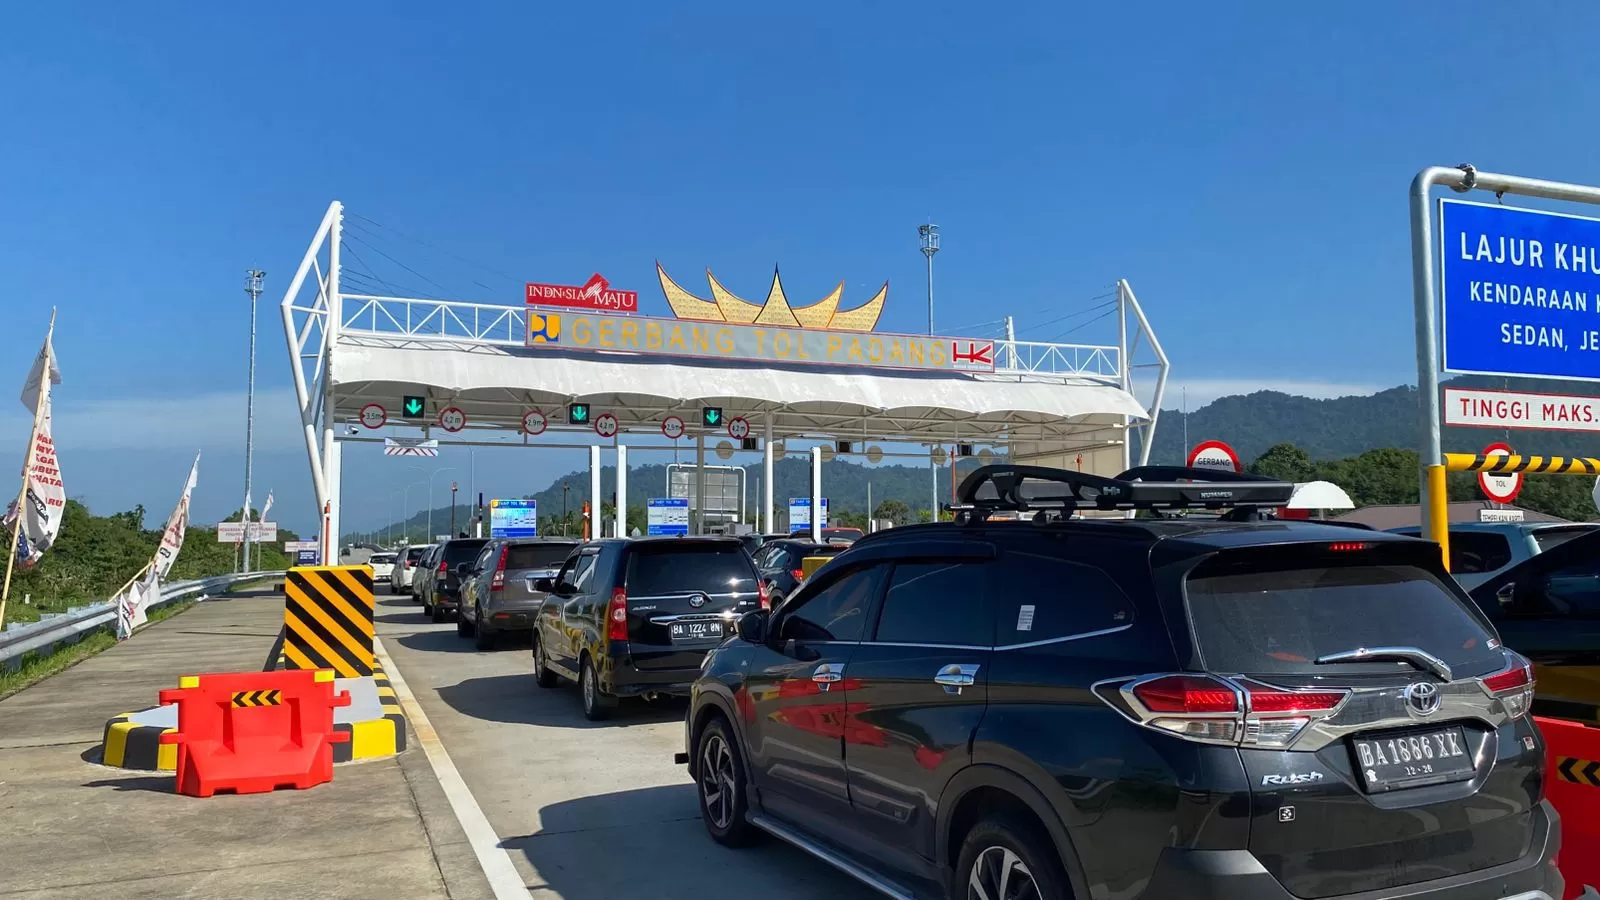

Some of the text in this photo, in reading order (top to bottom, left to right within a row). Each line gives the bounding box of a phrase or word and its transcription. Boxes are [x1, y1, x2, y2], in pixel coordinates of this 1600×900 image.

[1461, 231, 1544, 269] LAJUR
[594, 290, 635, 309] MAJU
[1470, 280, 1587, 312] KENDARAAN
[571, 317, 735, 354] GERBANG
[752, 329, 811, 358] TOL
[827, 334, 946, 366] PADANG
[1501, 322, 1569, 352] SEDAN,
[1460, 398, 1599, 423] TINGGI MAKS.
[1197, 457, 1230, 467] GERBANG
[1495, 480, 1506, 488] TOL
[1358, 742, 1389, 768] BA
[1388, 735, 1434, 766] 1886
[1261, 771, 1324, 786] Rush
